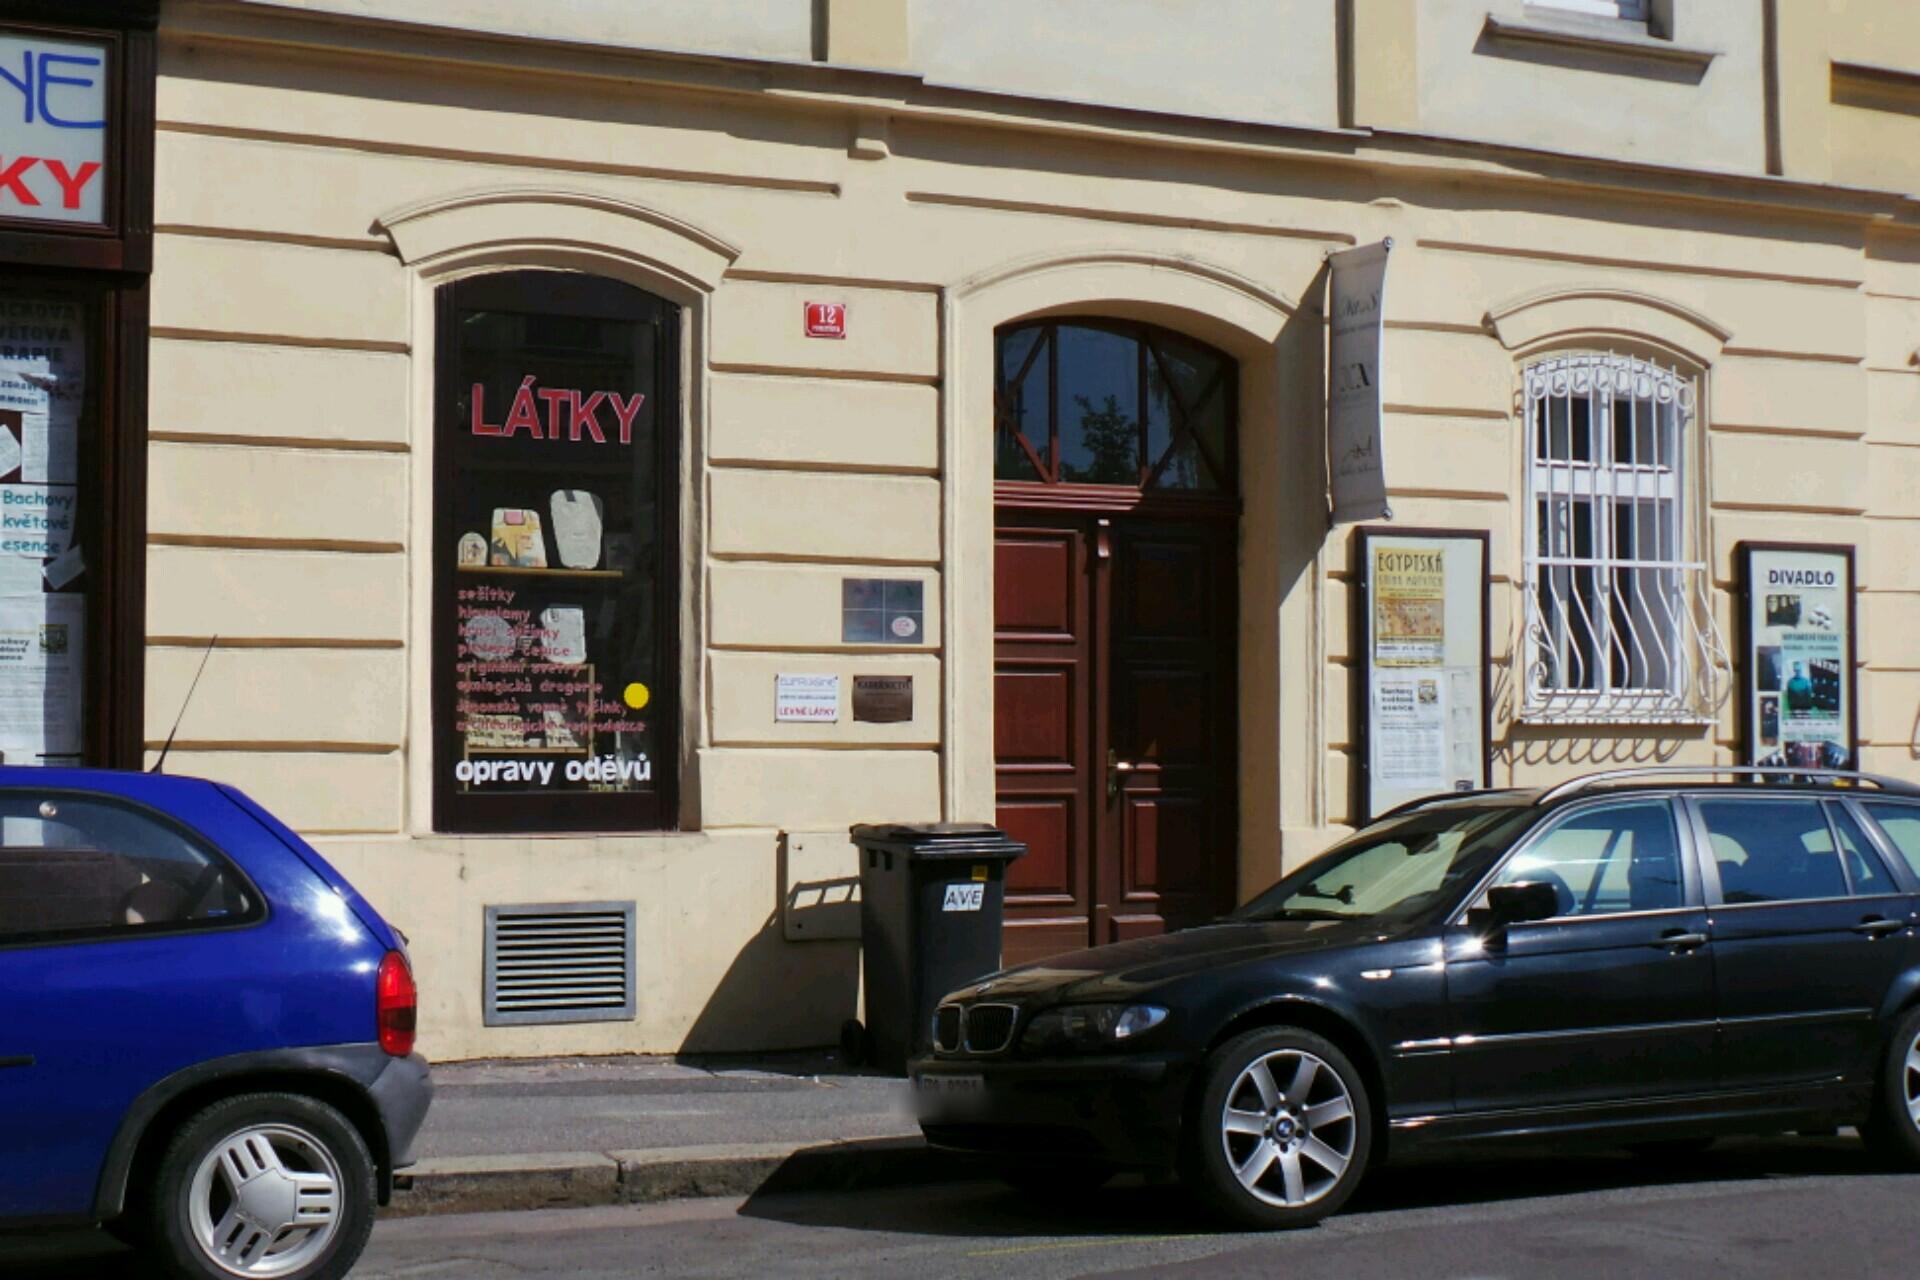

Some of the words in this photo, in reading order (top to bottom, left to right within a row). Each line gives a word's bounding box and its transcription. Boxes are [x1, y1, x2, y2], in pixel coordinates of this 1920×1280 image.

[818, 304, 837, 324] 12
[471, 375, 646, 445] LÁTKY
[3, 490, 73, 511] Bachovy
[3, 513, 70, 531] květové
[2, 539, 61, 555] esence
[1768, 569, 1836, 586] DIVADLO
[455, 757, 555, 785] opravy
[565, 752, 651, 784] oděvů
[946, 890, 983, 906] AVE
